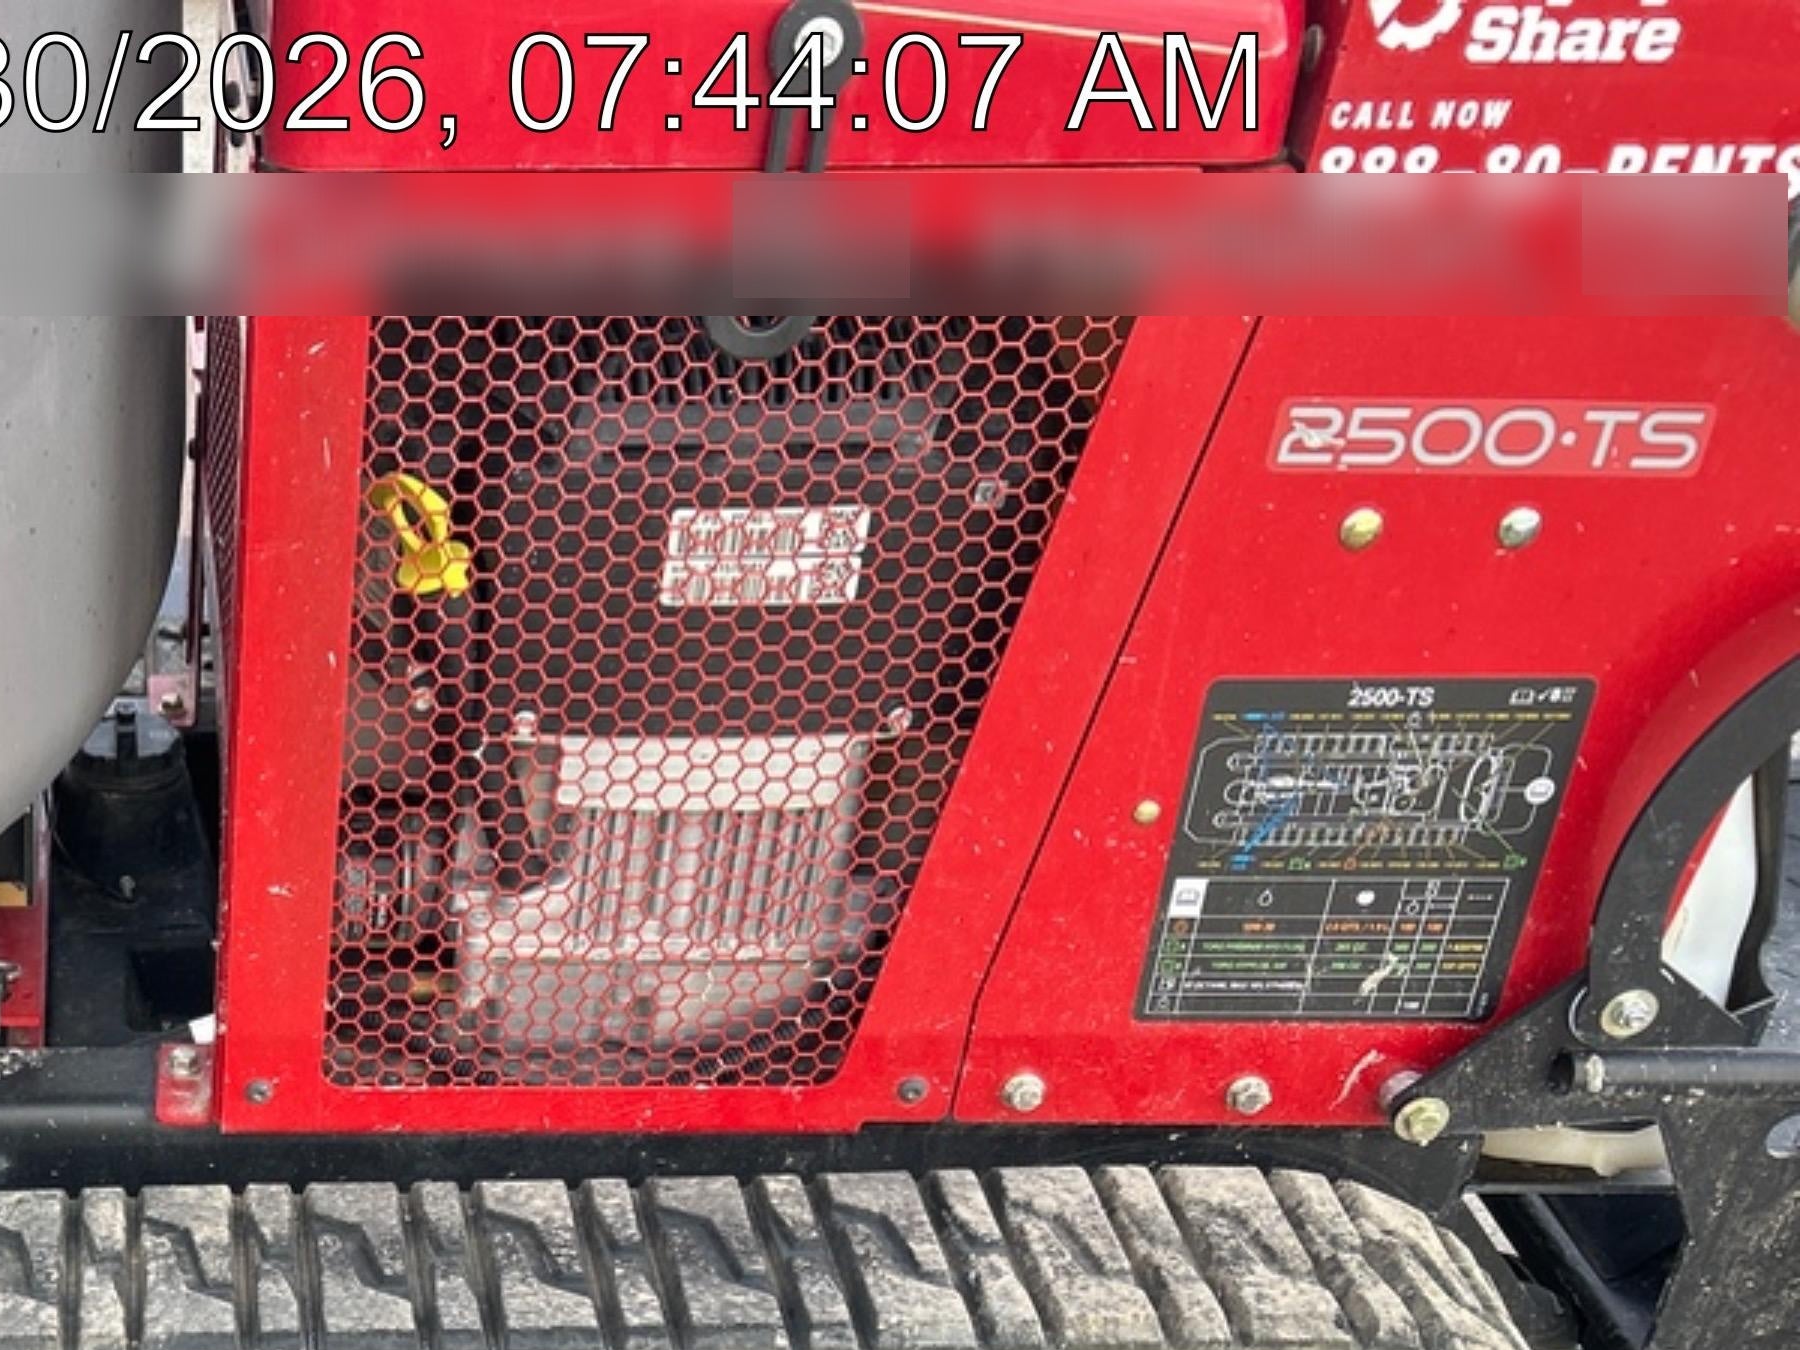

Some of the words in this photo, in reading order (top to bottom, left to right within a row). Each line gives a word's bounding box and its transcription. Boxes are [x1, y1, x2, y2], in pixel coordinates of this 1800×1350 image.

[1465, 5, 1681, 63] Share
[1329, 101, 1415, 130] CALL
[1431, 100, 1512, 129] NOW
